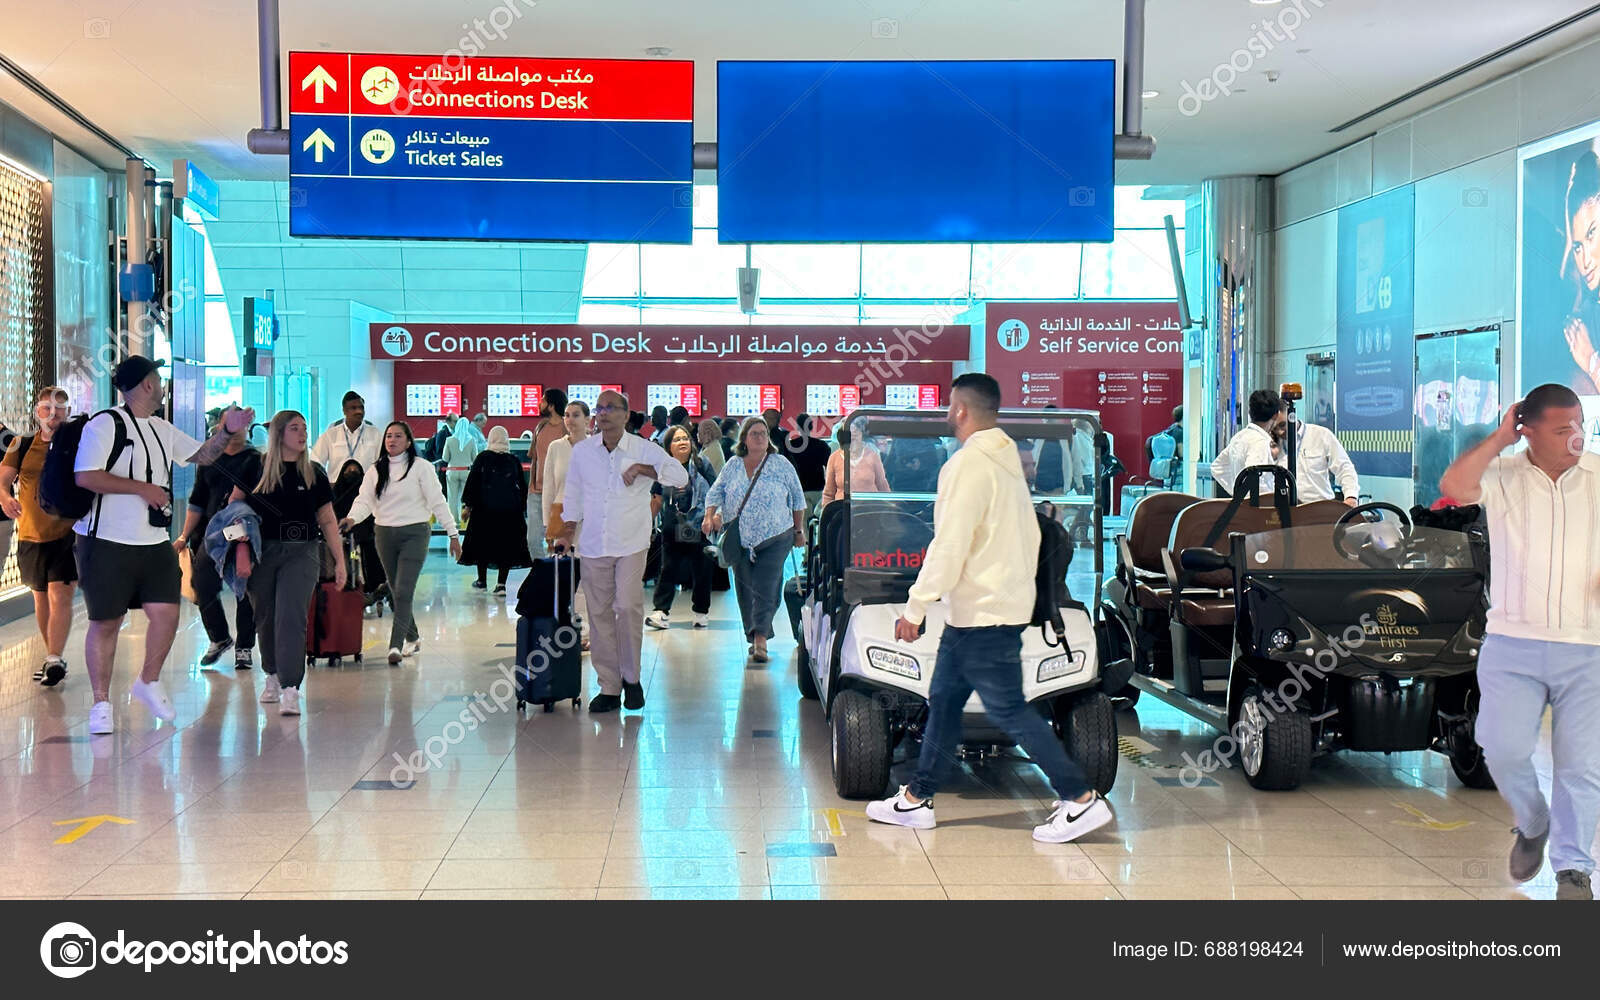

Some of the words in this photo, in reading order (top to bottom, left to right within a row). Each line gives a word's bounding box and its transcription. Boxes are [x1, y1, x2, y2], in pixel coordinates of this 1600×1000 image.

[408, 65, 472, 85] الرحلات
[476, 65, 542, 86] مواصلة
[547, 68, 594, 87] مكتب
[408, 88, 535, 109] Connections
[541, 91, 589, 110] Desk
[404, 130, 438, 147] تذاكر
[440, 130, 490, 148] مبيعات
[404, 149, 457, 166] Ticket
[460, 150, 504, 167] Sales
[1039, 316, 1082, 334] الذاتية
[1086, 316, 1131, 332] الخدمة
[424, 331, 583, 353] Connections
[591, 331, 652, 353] Desk
[664, 334, 741, 358] الرحلات
[747, 334, 828, 358] مواصلة
[834, 336, 887, 354] خدمة
[1039, 337, 1073, 353] Self
[1077, 337, 1139, 353] Service
[1362, 623, 1420, 636] Emirates
[1380, 636, 1407, 648] First
